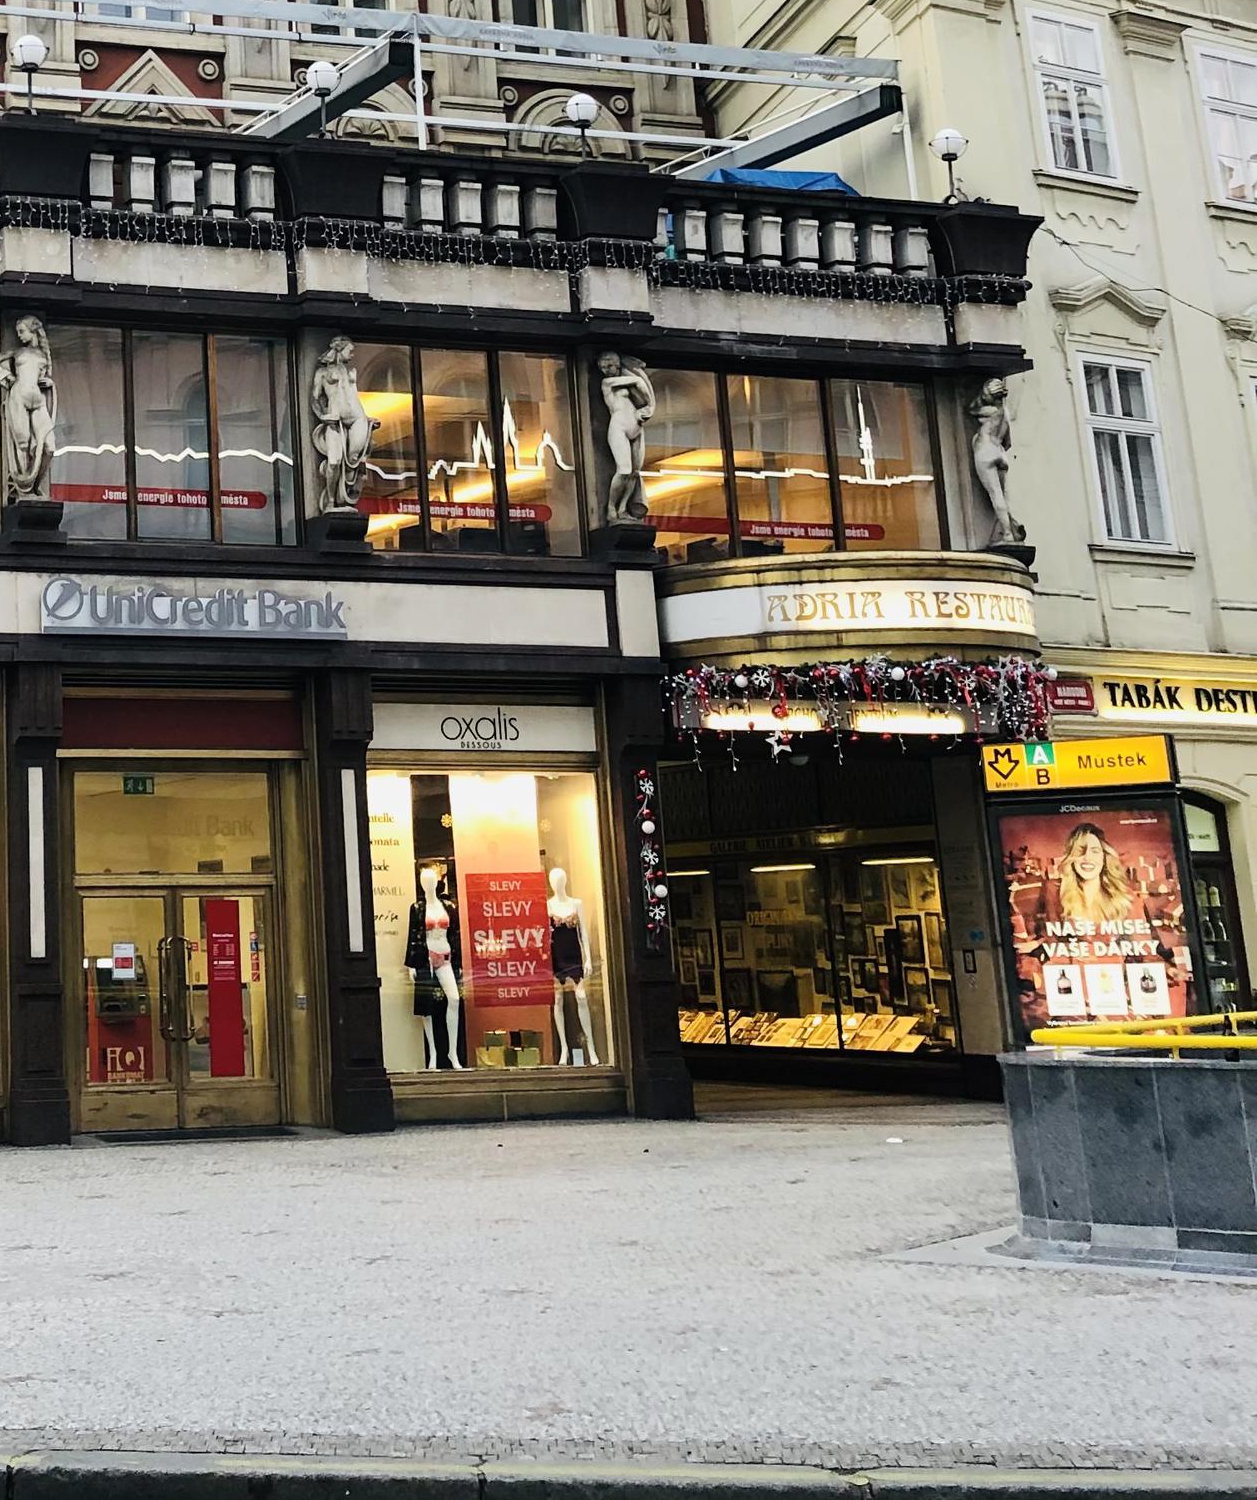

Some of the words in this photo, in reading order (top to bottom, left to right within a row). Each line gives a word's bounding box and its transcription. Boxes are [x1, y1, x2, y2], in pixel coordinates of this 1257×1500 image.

[102, 489, 127, 500] Jsme
[137, 492, 173, 504] energie
[177, 493, 207, 505] tohoto
[221, 494, 248, 505] města
[397, 502, 420, 513] Jsme
[430, 505, 463, 517] energie
[467, 506, 495, 517] tohoto
[509, 507, 535, 518] města
[89, 584, 248, 627] UniCredit
[256, 588, 347, 629] Bank
[767, 590, 885, 623] ADRIA
[1103, 678, 1184, 710] TABÁK
[441, 707, 519, 740] oxalis
[461, 741, 501, 749] DESSOUS
[1032, 745, 1049, 764] A
[1036, 769, 1050, 785] B
[489, 880, 521, 891] SLEVY
[483, 900, 532, 917] SLEVY
[1046, 917, 1096, 936] NAŠE
[1101, 919, 1151, 935] MISE:
[474, 928, 545, 950] SLEVY
[1043, 938, 1089, 957] VAŠE
[1094, 937, 1159, 957] DÁRKY
[487, 961, 537, 977] SLEVY
[498, 987, 531, 998] SLEVY
